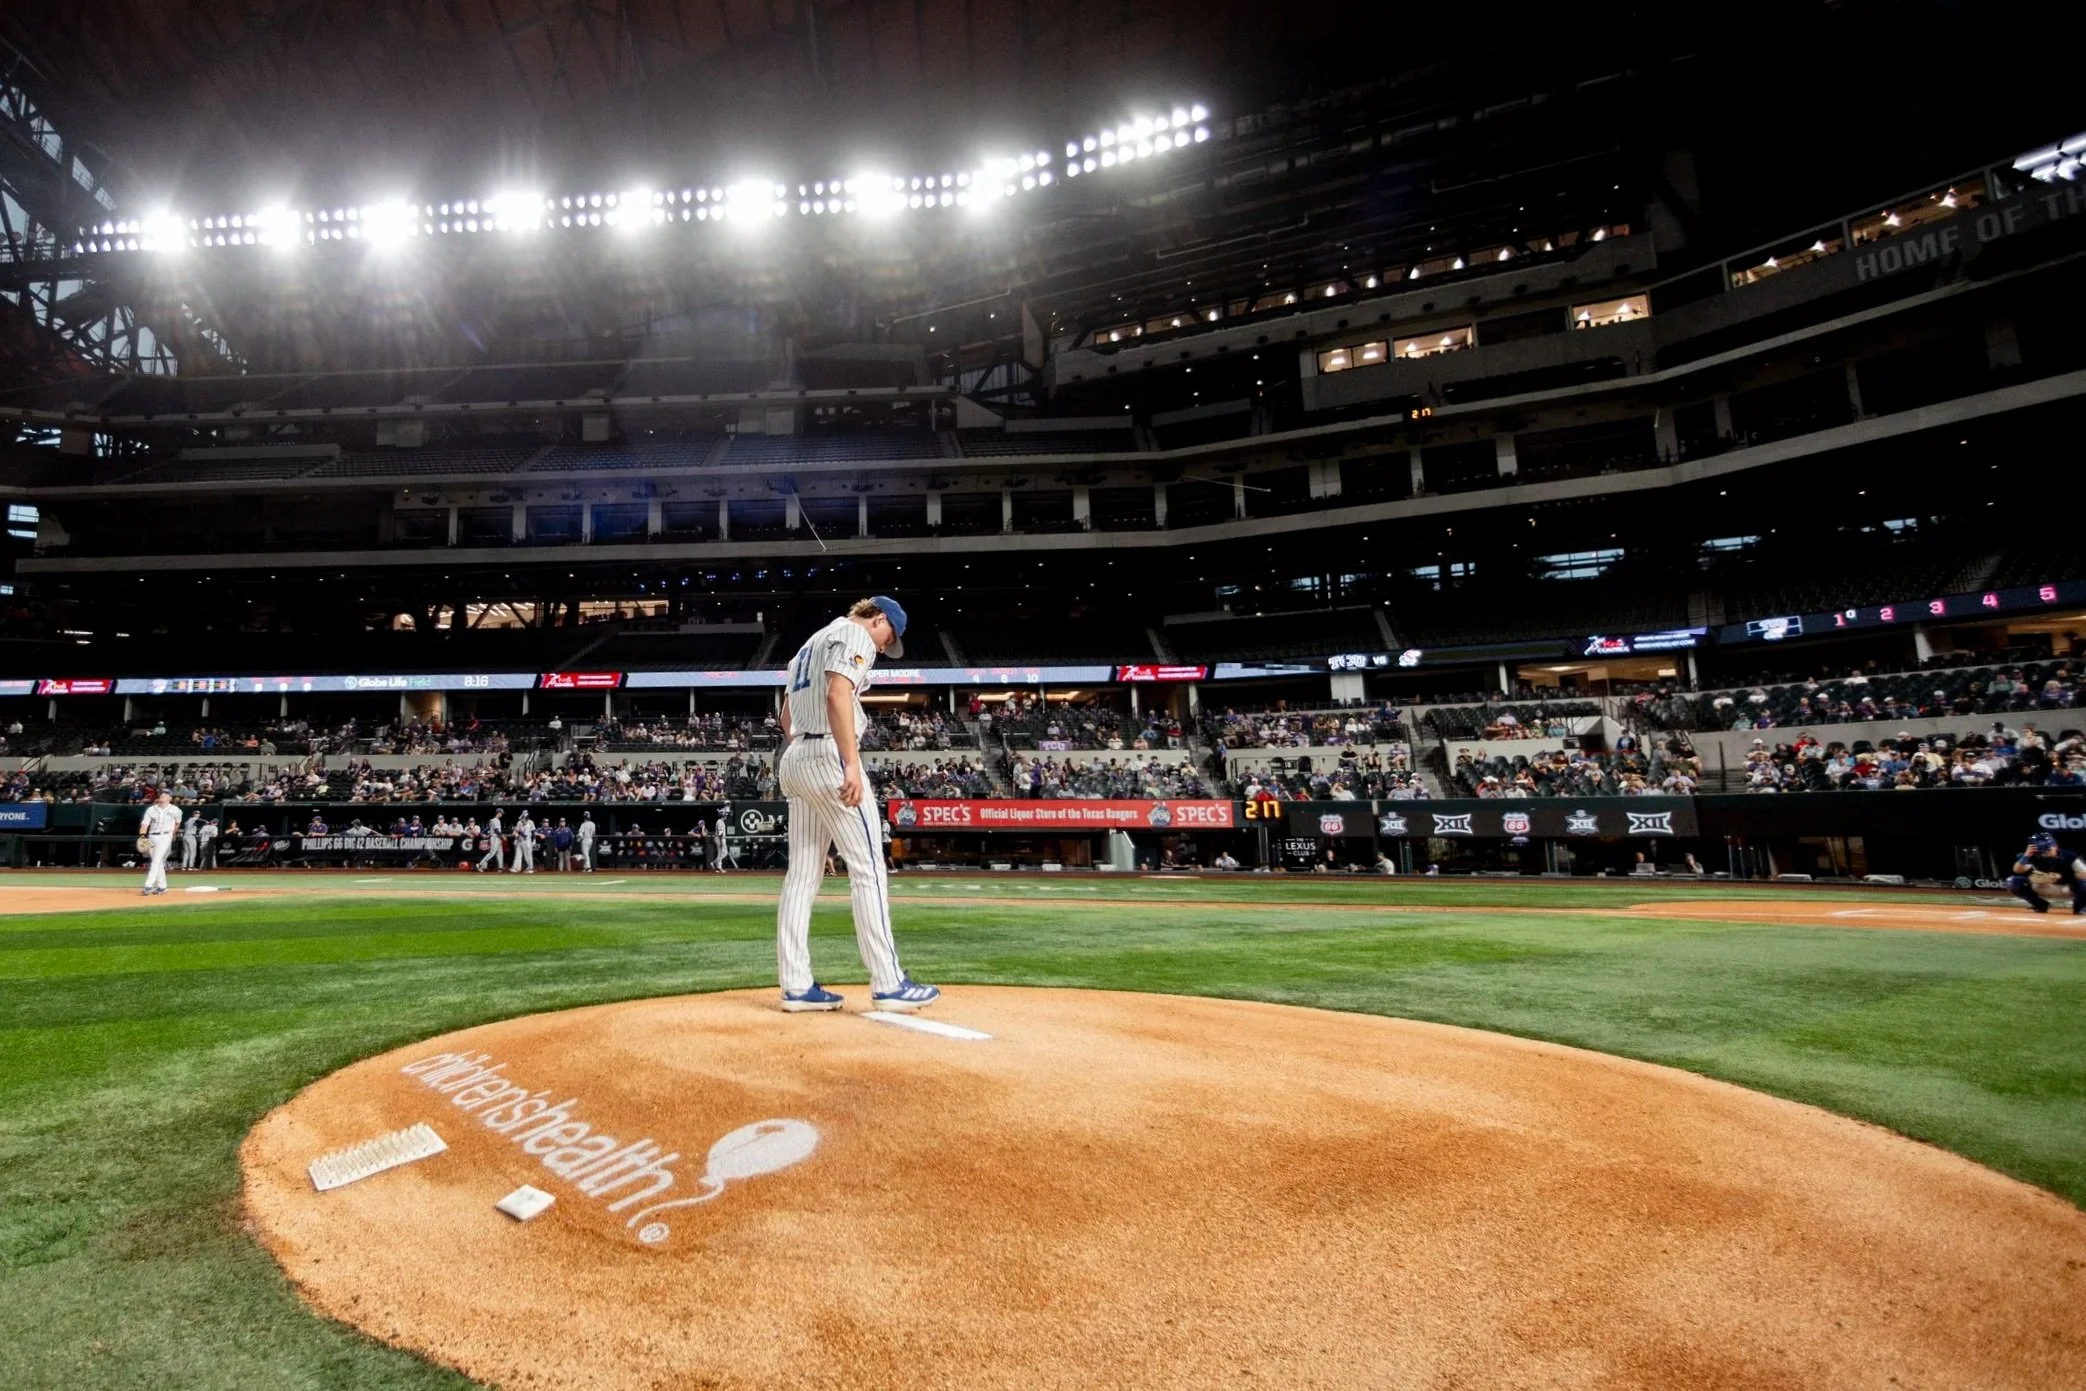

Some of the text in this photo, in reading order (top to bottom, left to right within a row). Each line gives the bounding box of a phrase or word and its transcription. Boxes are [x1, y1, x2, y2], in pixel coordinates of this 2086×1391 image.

[1855, 224, 1960, 283] HOME
[1975, 202, 2026, 243] OF
[1879, 607, 1893, 621] 2
[1929, 600, 1945, 615] 3
[1982, 593, 1998, 608] 4
[2039, 586, 2057, 601] 5
[1327, 654, 1367, 671] TCU
[890, 669, 921, 678] MOORE
[358, 676, 432, 688] Globe Life Field
[922, 803, 1138, 822] SPEC'S Official Liquor Store of the Texas Rangers
[1176, 803, 1228, 822] SPEC'S
[1324, 821, 1339, 832] 66
[1508, 820, 1524, 830] 66
[2037, 813, 2086, 830] Glo
[302, 837, 333, 851] PHILLIPS
[333, 838, 344, 850] 66
[400, 837, 454, 850] CHAMPIONSHIP
[1285, 842, 1316, 850] LEXUS
